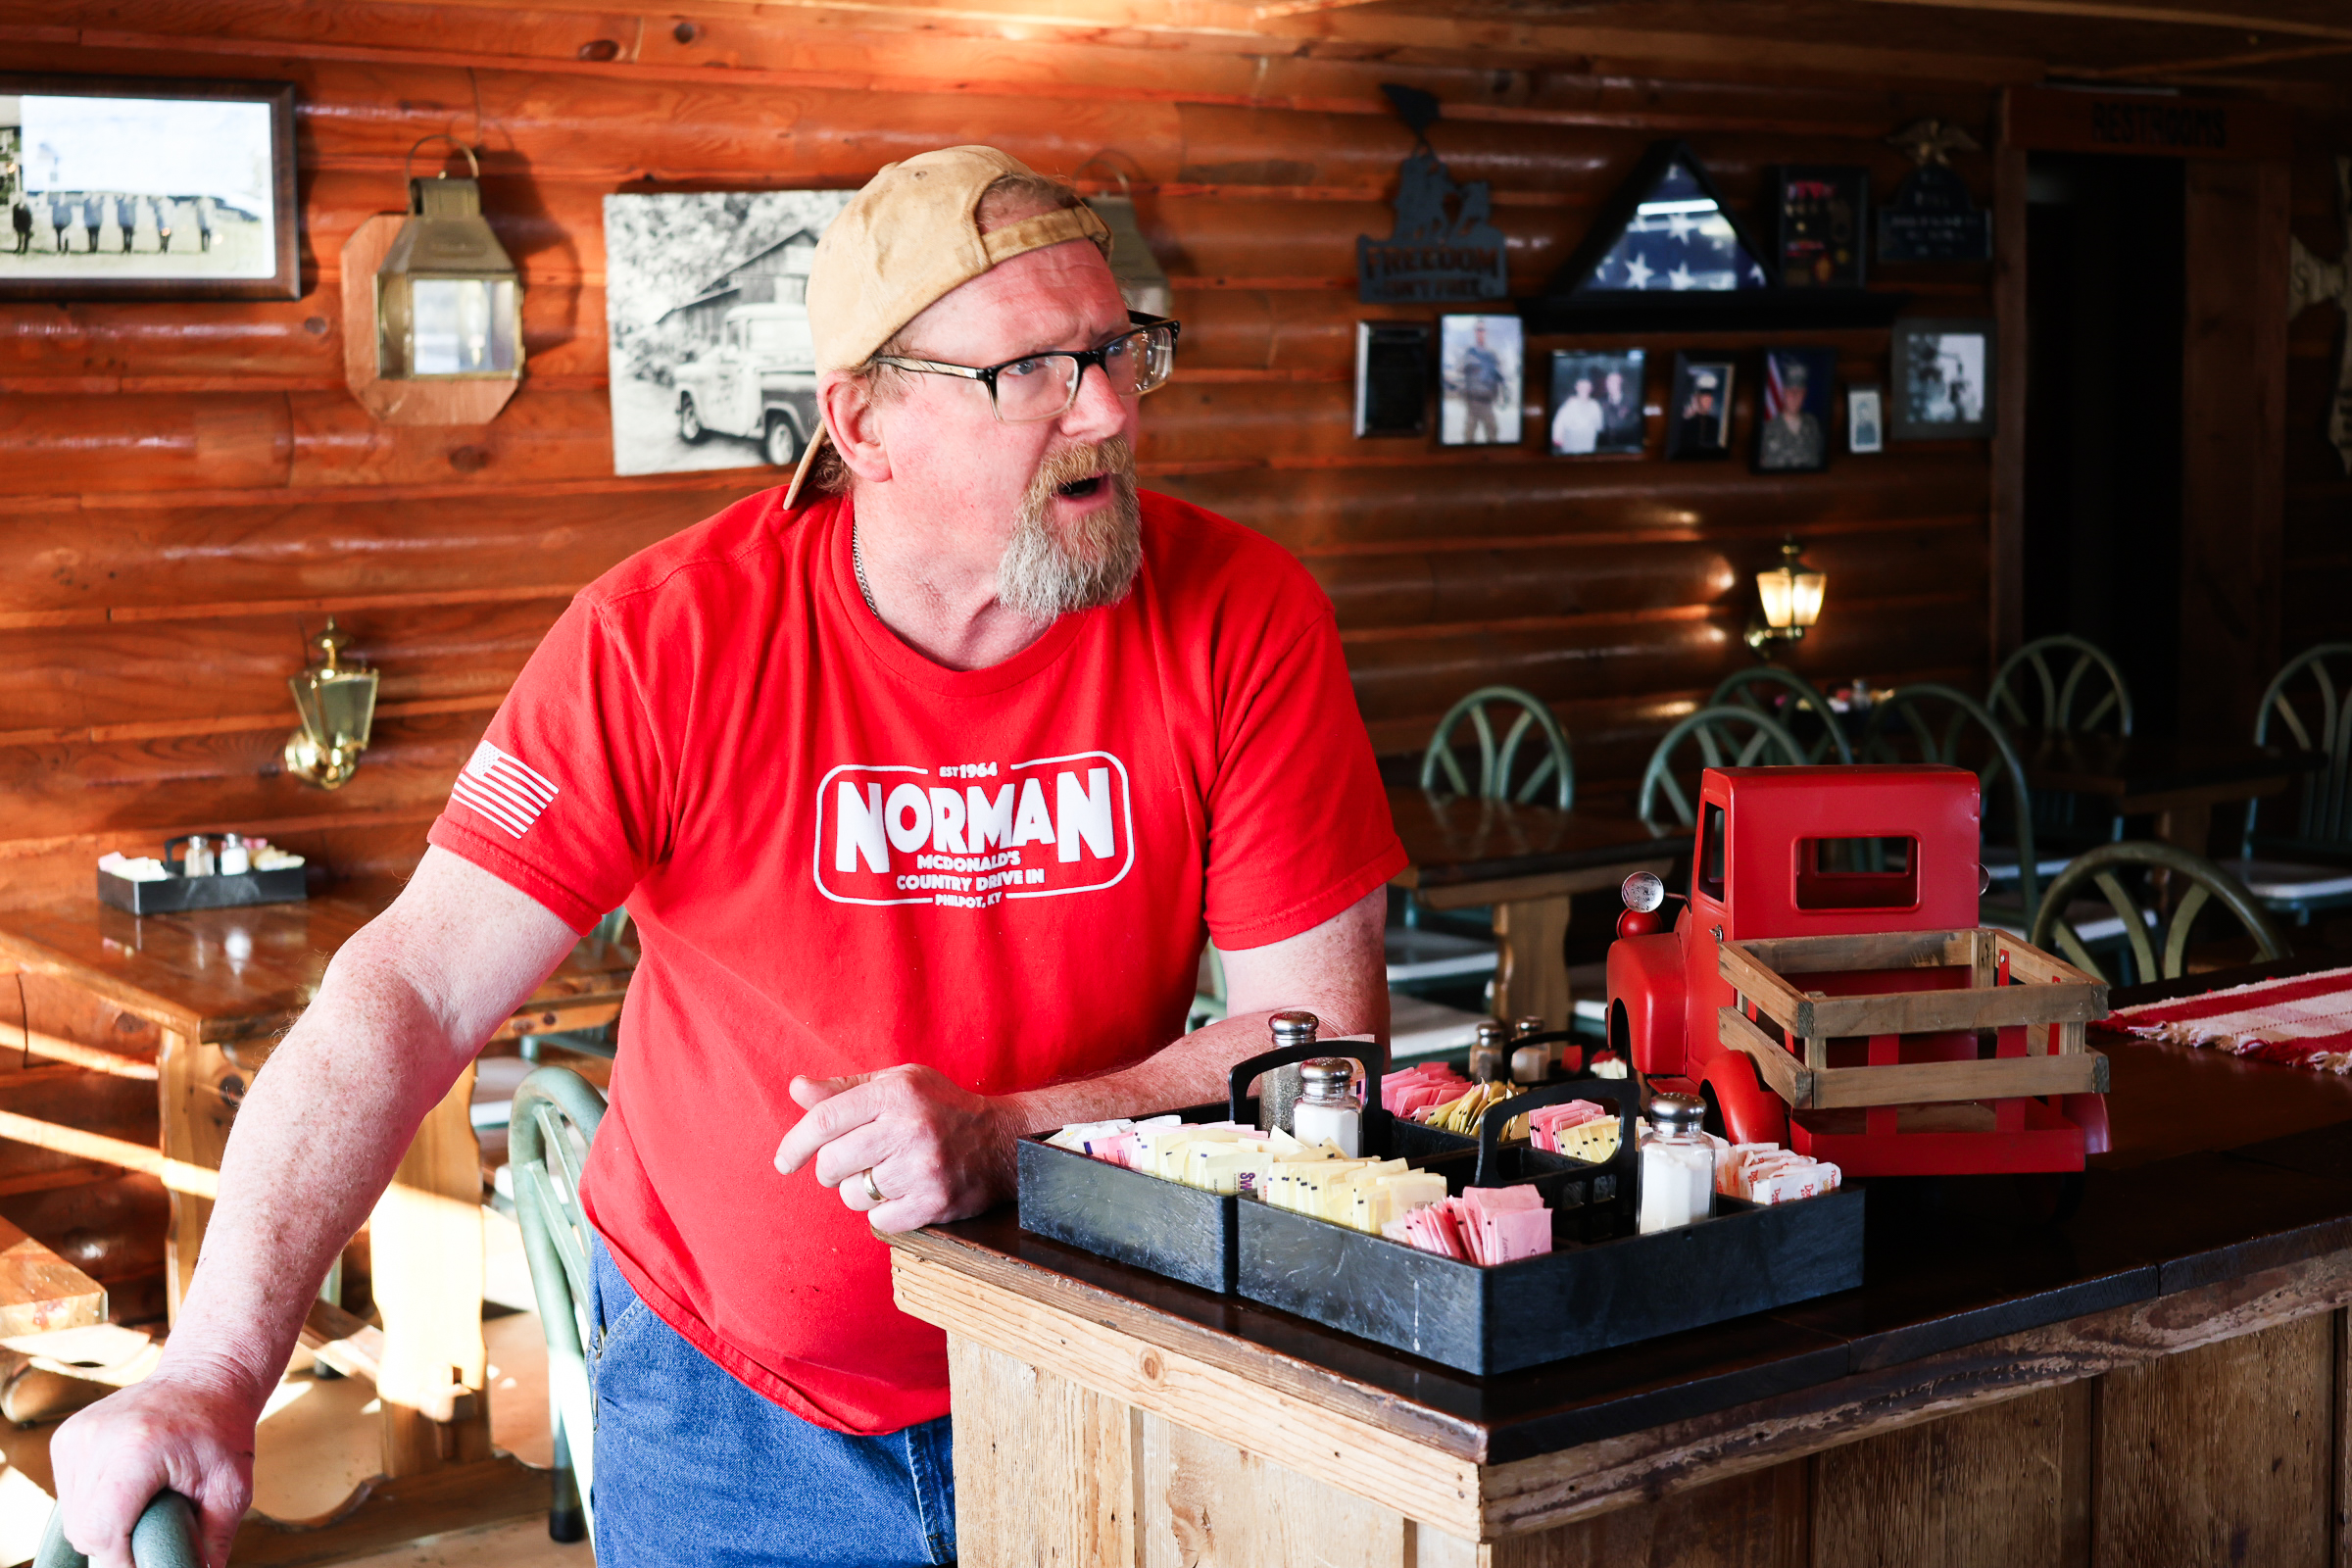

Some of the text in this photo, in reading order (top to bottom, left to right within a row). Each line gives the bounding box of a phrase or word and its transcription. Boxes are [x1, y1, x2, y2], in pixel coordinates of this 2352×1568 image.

[2091, 101, 2227, 149] RESTROOMS
[1365, 246, 1498, 280] FREEDOM
[939, 761, 999, 779] EST 1964
[835, 766, 1115, 874] NORMAN
[916, 850, 1021, 873] MCDONALD'S
[897, 867, 1046, 893] COUNTRY DRIVE IN
[935, 891, 1003, 909] PHILPOT, KY
